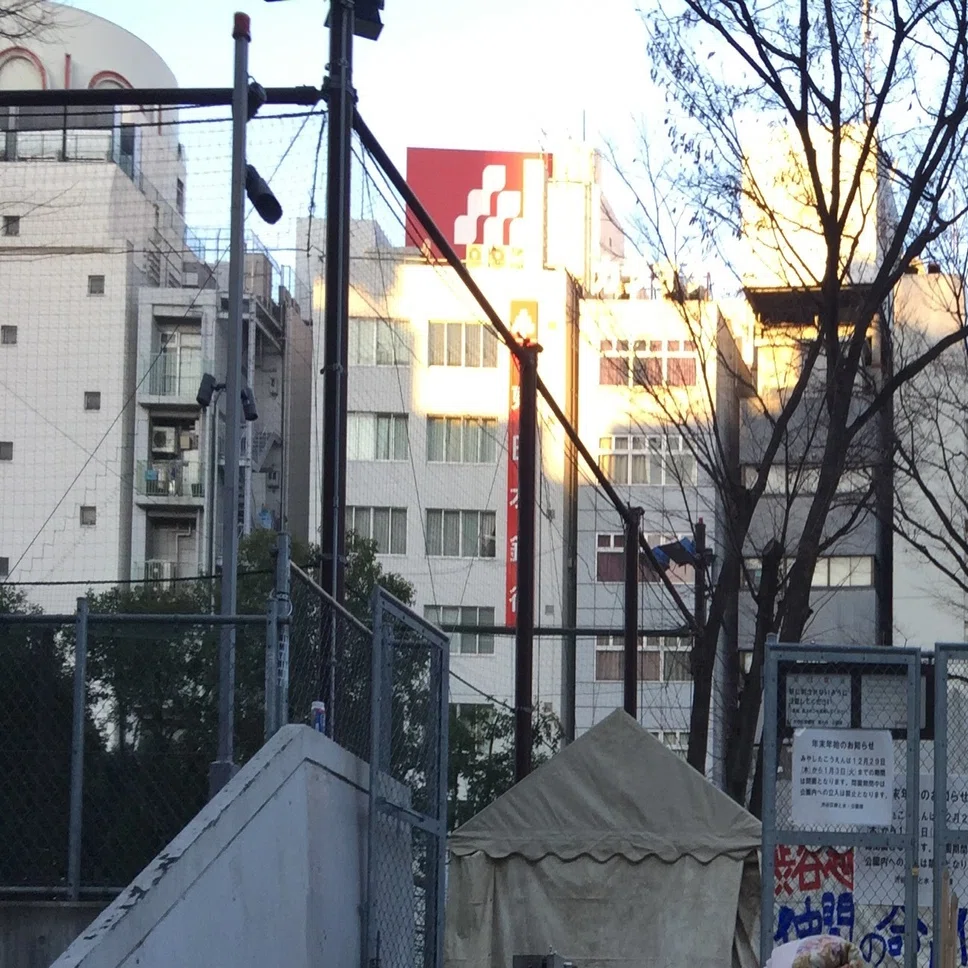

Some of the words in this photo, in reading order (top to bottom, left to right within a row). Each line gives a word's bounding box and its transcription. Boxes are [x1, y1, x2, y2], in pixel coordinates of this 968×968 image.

[811, 739, 875, 751] 年末年始のお知らせ
